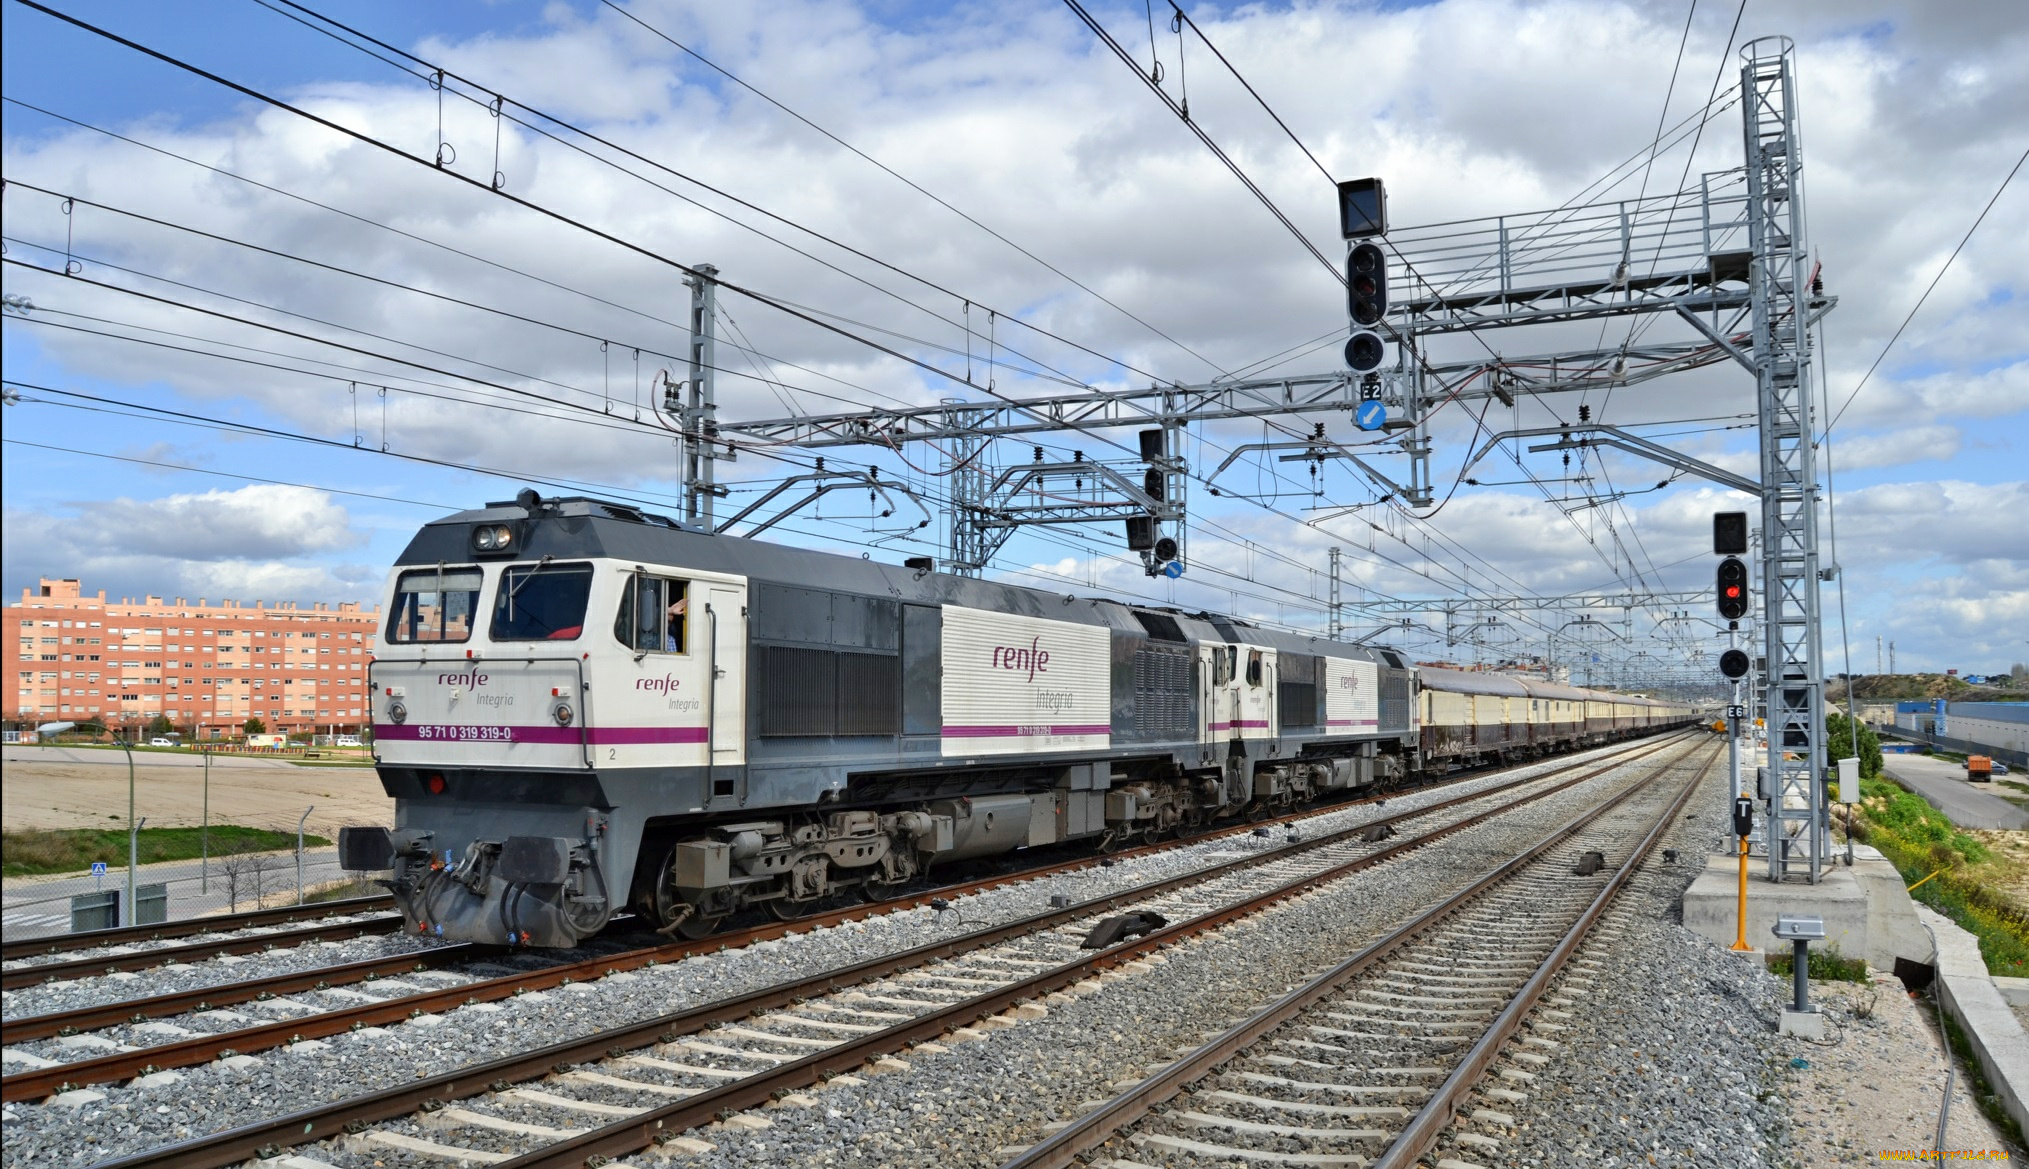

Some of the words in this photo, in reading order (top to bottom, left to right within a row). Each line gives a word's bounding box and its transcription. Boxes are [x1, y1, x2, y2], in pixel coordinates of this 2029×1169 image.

[1362, 385, 1380, 399] E2
[992, 635, 1050, 684] renfe
[438, 667, 488, 692] renfe
[636, 672, 680, 697] renfe
[476, 693, 514, 709] Integria
[668, 698, 700, 713] Integria
[1036, 687, 1073, 715] Integria
[1728, 707, 1743, 717] E6
[418, 726, 432, 738] 95
[434, 726, 447, 738] 71
[450, 726, 457, 738] 0
[459, 727, 478, 739] 319
[480, 727, 511, 739] 319-0
[609, 748, 616, 761] 2
[1738, 801, 1750, 817] T
